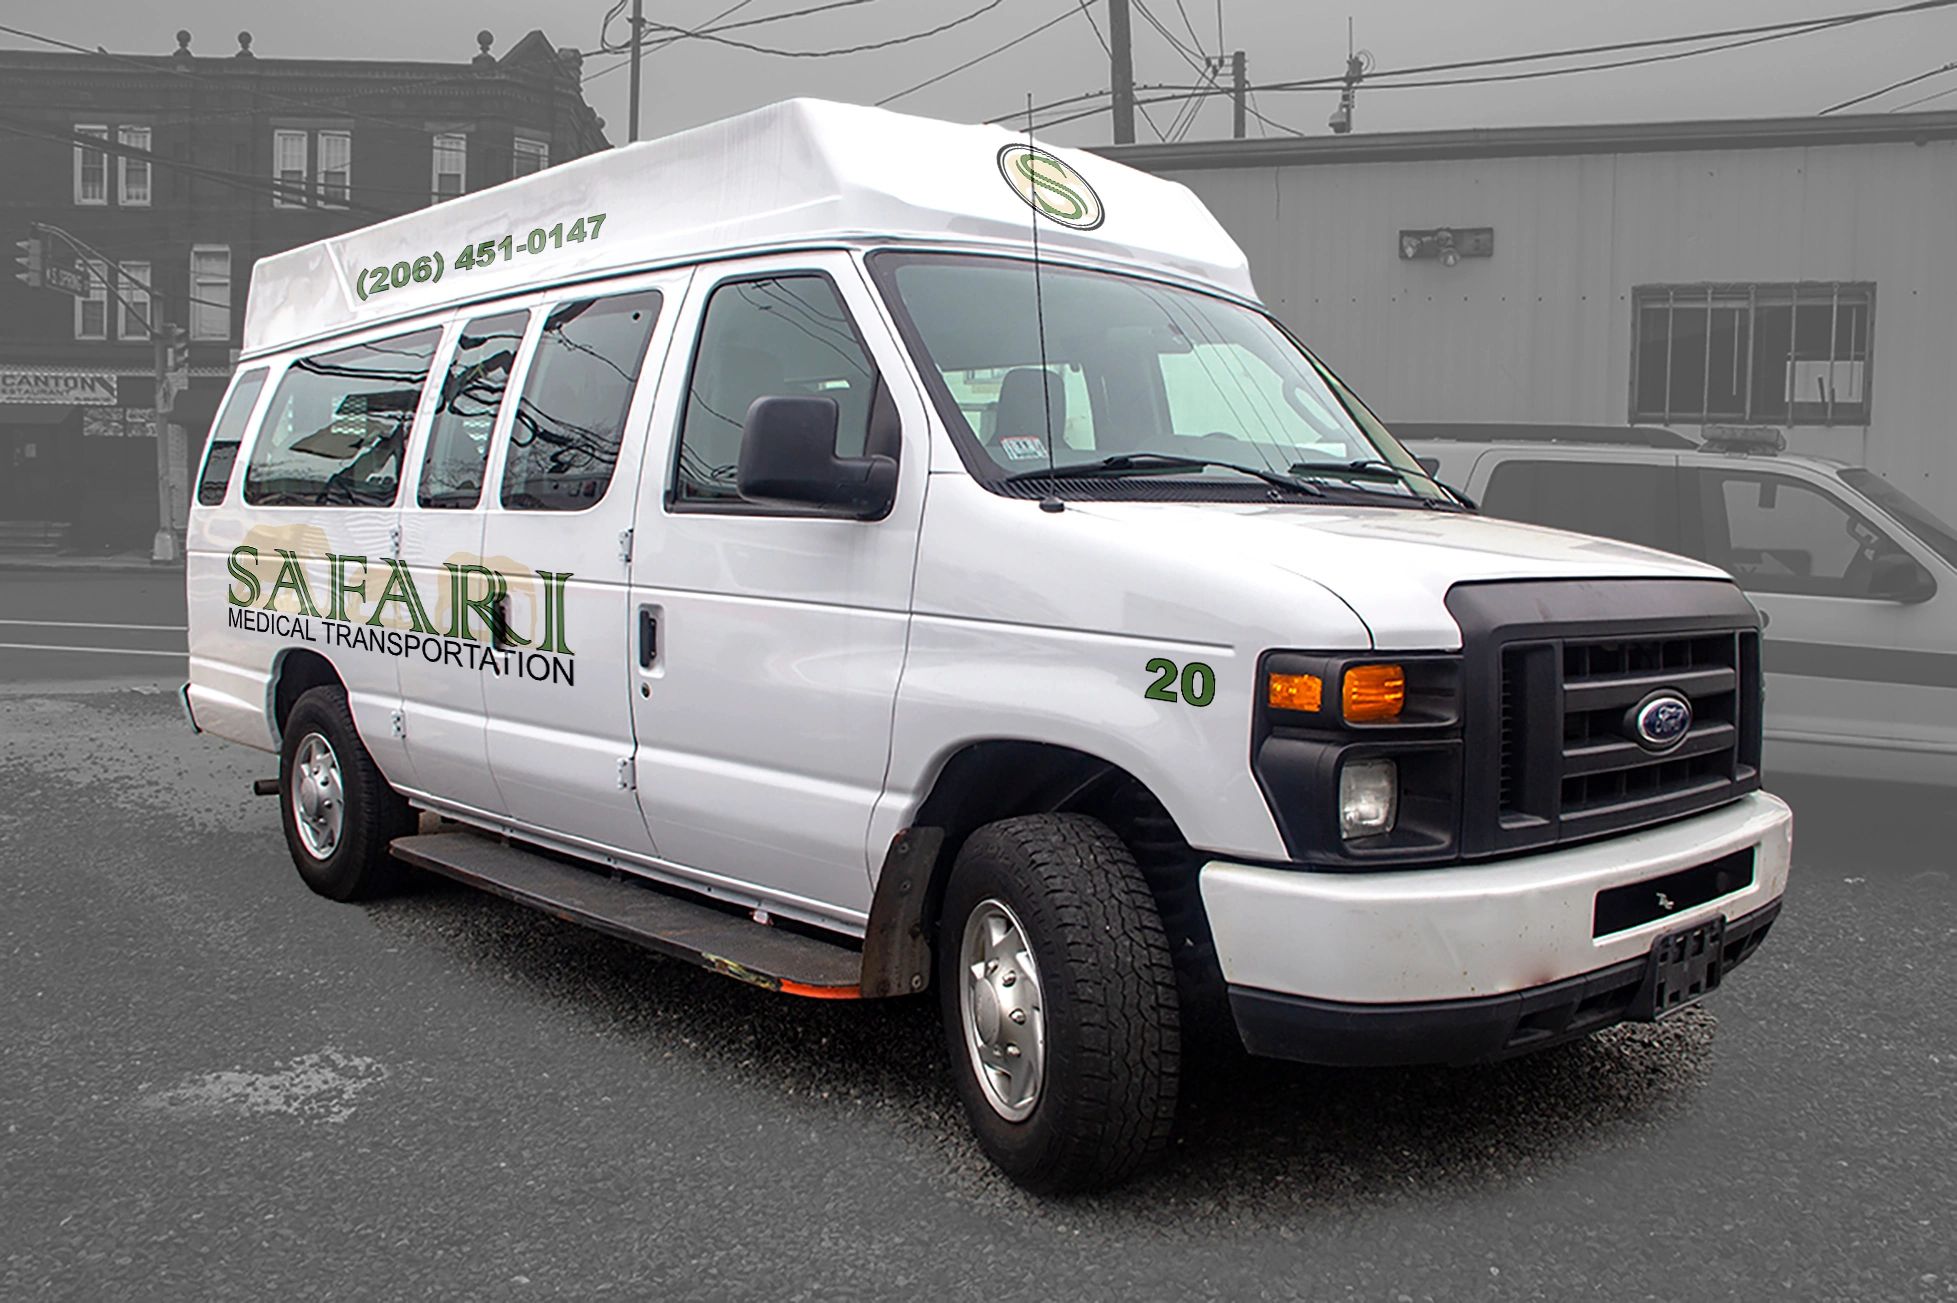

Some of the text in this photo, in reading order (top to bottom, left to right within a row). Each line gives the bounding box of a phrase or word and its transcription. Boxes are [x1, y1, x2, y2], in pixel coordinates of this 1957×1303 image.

[356, 213, 607, 302] (206) 451-0147
[0, 388, 71, 397] ESTAURANT
[2, 374, 96, 393] CANTON
[227, 545, 575, 656] SAFARI
[228, 607, 575, 687] MEDICAL TRANSPORTATION
[1144, 657, 1216, 708] 20
